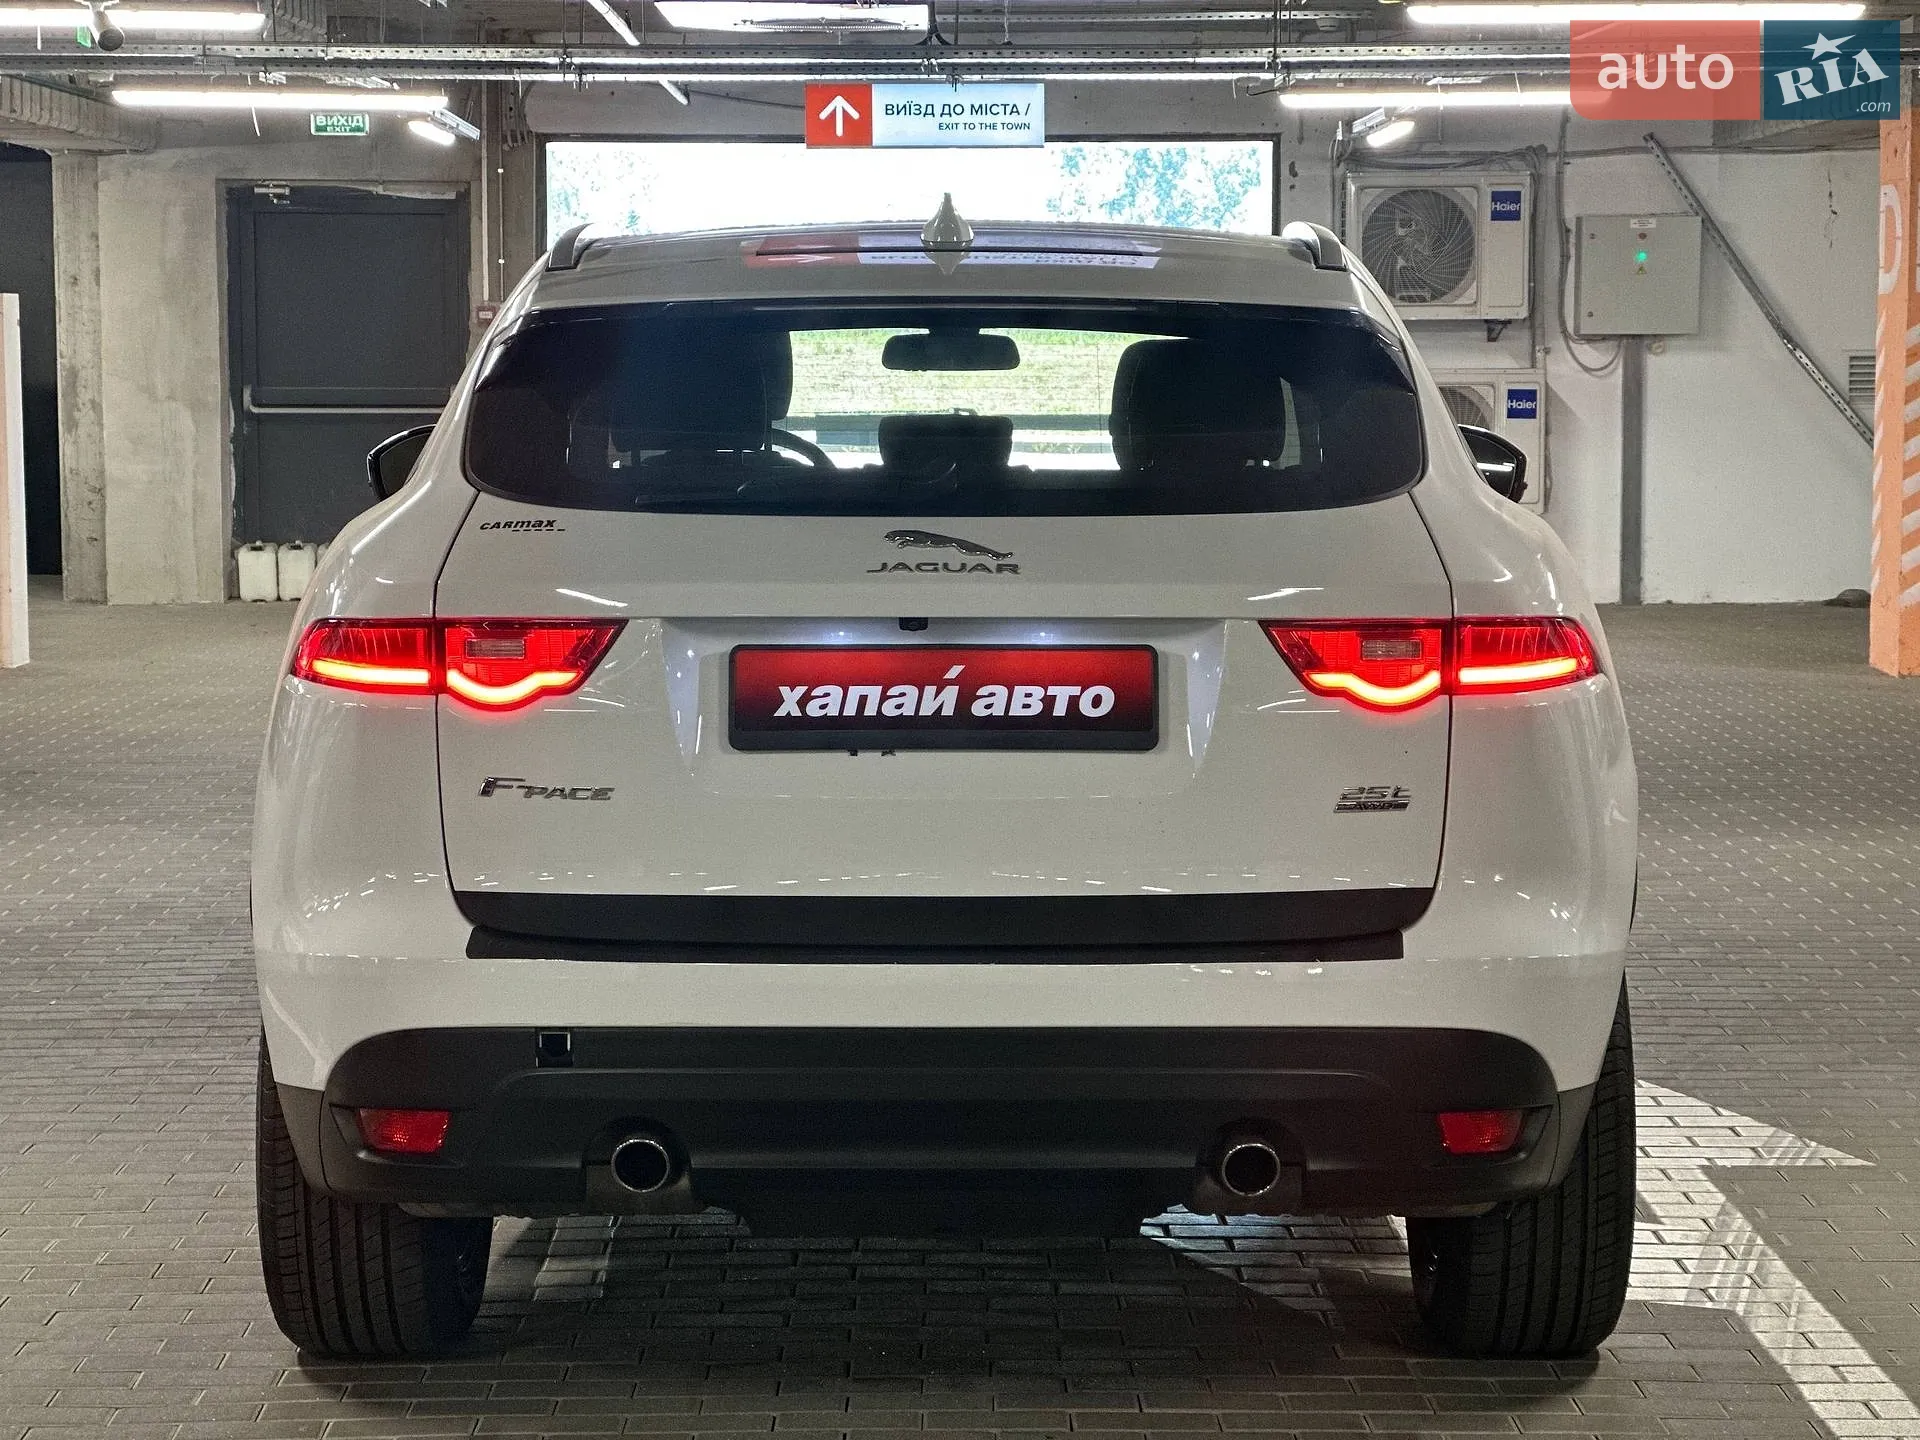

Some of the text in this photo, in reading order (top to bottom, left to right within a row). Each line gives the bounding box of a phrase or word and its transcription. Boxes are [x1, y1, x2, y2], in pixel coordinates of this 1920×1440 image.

[885, 101, 935, 118] ВИЇЗД
[940, 103, 965, 118] ДО
[970, 103, 1021, 116] МІСТА
[315, 115, 364, 128] ВИХІД
[938, 122, 1030, 131] EXIT TO THE TOWN
[1491, 200, 1521, 212] Haier
[1507, 398, 1537, 410] Haier
[866, 562, 1021, 575] JAGUAR
[971, 685, 1114, 717] авто
